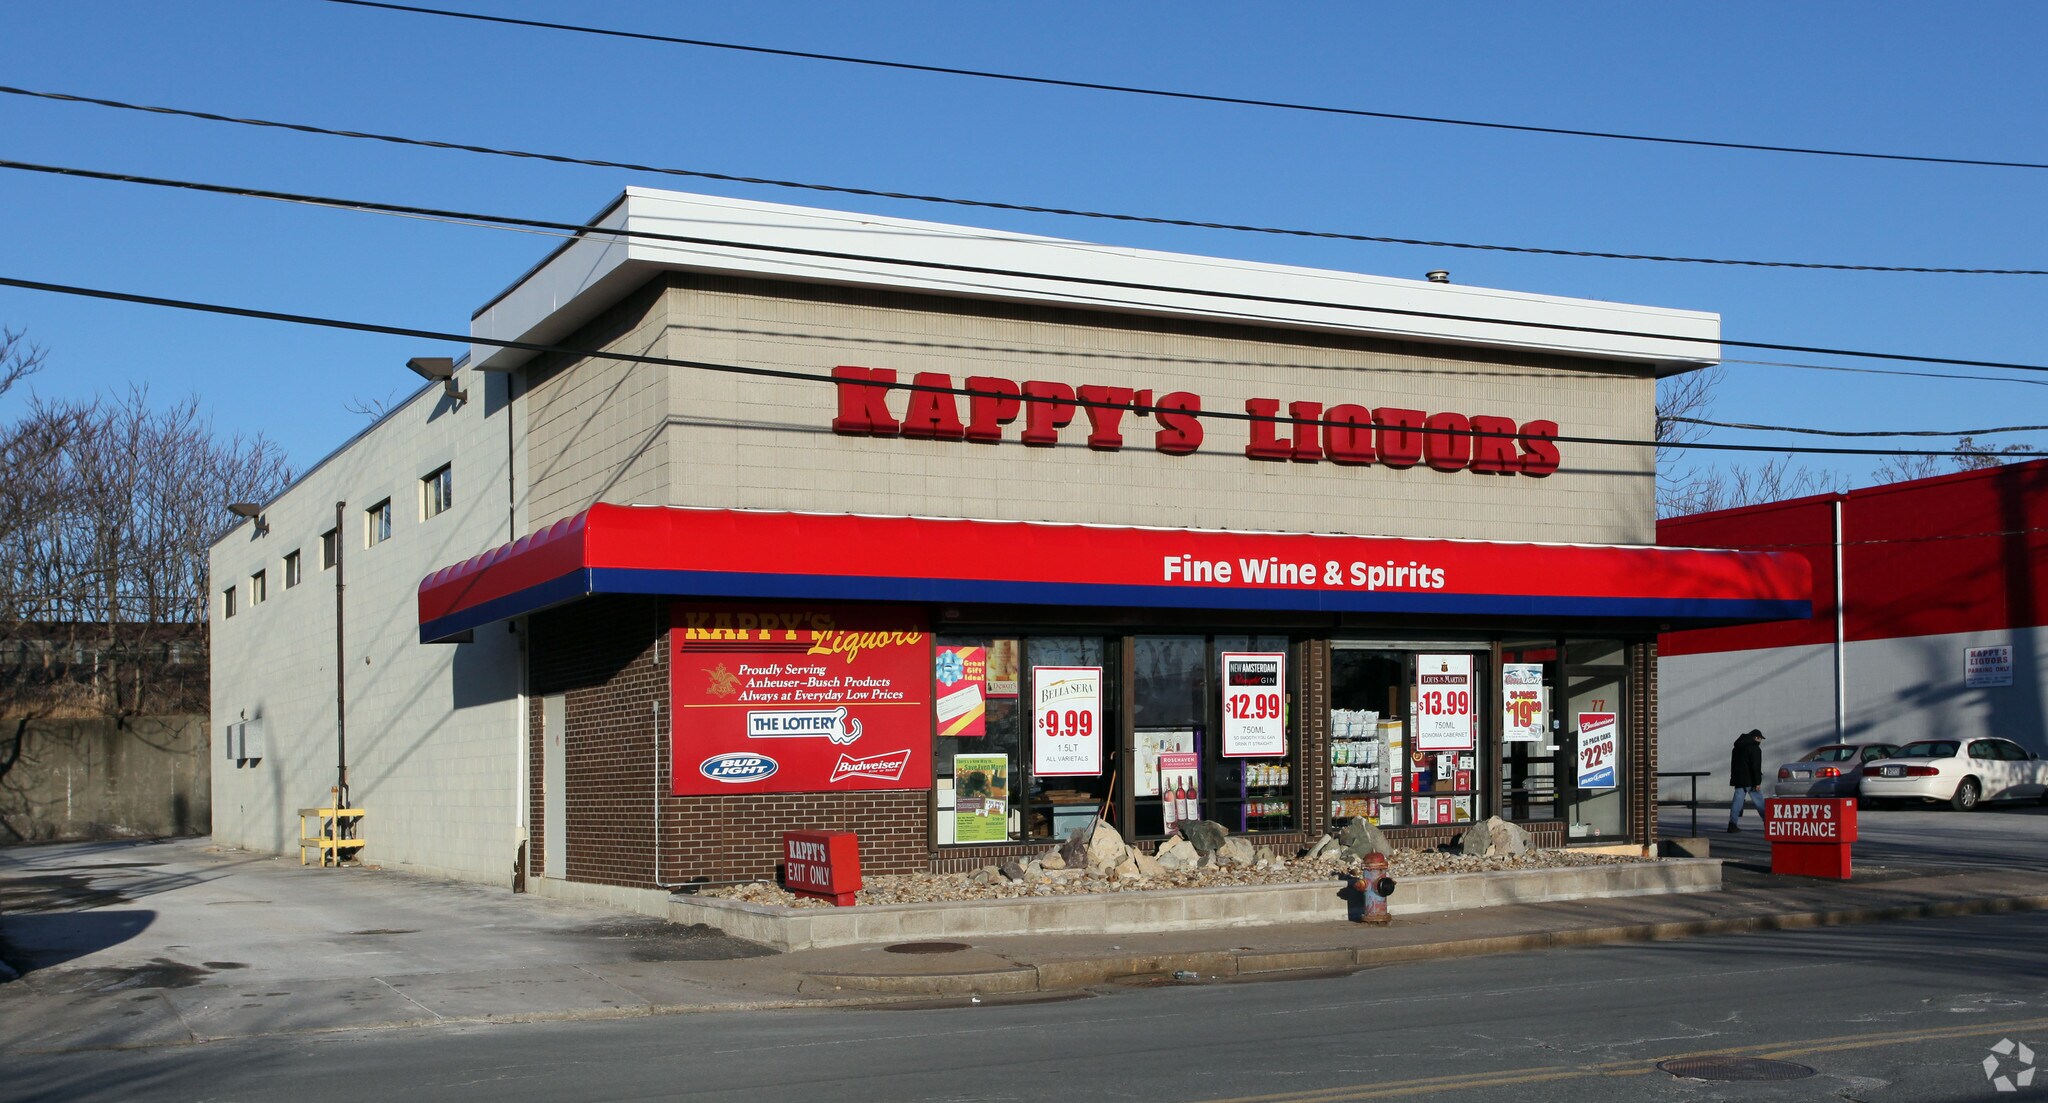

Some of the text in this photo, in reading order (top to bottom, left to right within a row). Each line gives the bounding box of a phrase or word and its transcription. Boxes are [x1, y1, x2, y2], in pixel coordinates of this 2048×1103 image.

[832, 366, 1560, 478] KAPPY'S LIQUORS
[1164, 554, 1445, 590] Fine Wine & Spirits
[685, 612, 835, 640] KAPPY'S
[807, 624, 923, 664] Liquors
[1970, 649, 2007, 657] KAPPY'S
[1970, 656, 2008, 665] LIQUORS
[738, 664, 827, 677] Proudly Serving
[1230, 663, 1277, 673] NEW AMSTERDAM
[844, 676, 891, 687] Products
[738, 688, 904, 702] Always at Everyday Low Prices
[1226, 693, 1280, 719] $12.99
[1419, 691, 1468, 715] $13.99
[1591, 700, 1605, 712] 77
[754, 717, 837, 731] THE LOTTERY
[1039, 710, 1093, 737] $9.99
[1242, 726, 1266, 734] 750ML
[1435, 721, 1456, 730] 750ML
[1581, 717, 1614, 731] Budweiser
[720, 758, 761, 767] BUD
[838, 760, 903, 772] Budweiser
[711, 765, 768, 775] LIGHT
[1773, 804, 1831, 819] KAPPY'S
[1769, 821, 1836, 837] ENTRANCE
[789, 840, 826, 862] KAPPY'S
[788, 862, 829, 885] EXIT ONLY
